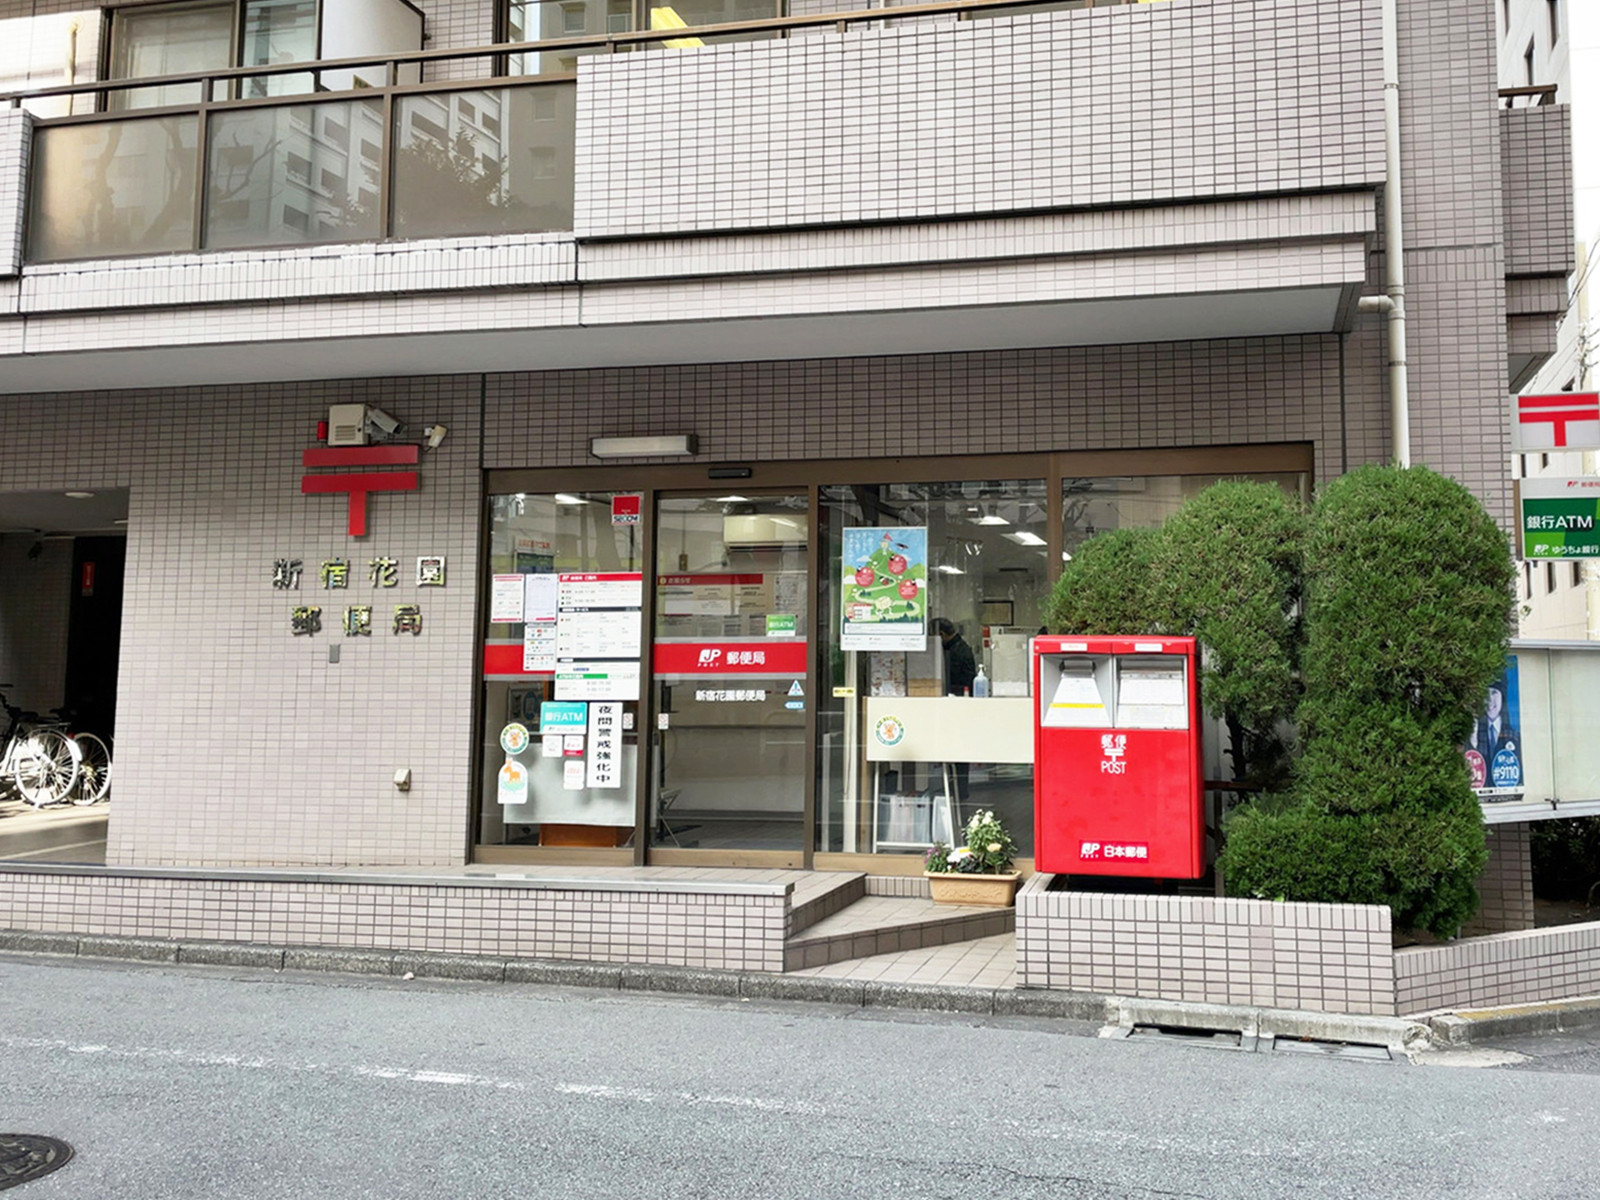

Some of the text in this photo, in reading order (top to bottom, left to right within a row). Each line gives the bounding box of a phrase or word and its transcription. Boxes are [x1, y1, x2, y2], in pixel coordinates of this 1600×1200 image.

[1527, 515, 1592, 529] 銀行ATM
[1552, 544, 1599, 554] ゆうちょ銀行
[271, 556, 447, 590] 新宿花園
[291, 604, 424, 638] 郵便局
[726, 651, 765, 665] 郵便局
[695, 690, 766, 702] 新宿花園郵便局
[595, 705, 613, 783] 夜間警戒強化中
[1101, 734, 1127, 750] 郵便
[1101, 761, 1127, 775] POST
[1493, 766, 1519, 779] #9110
[1104, 845, 1148, 860] 日本郵便
